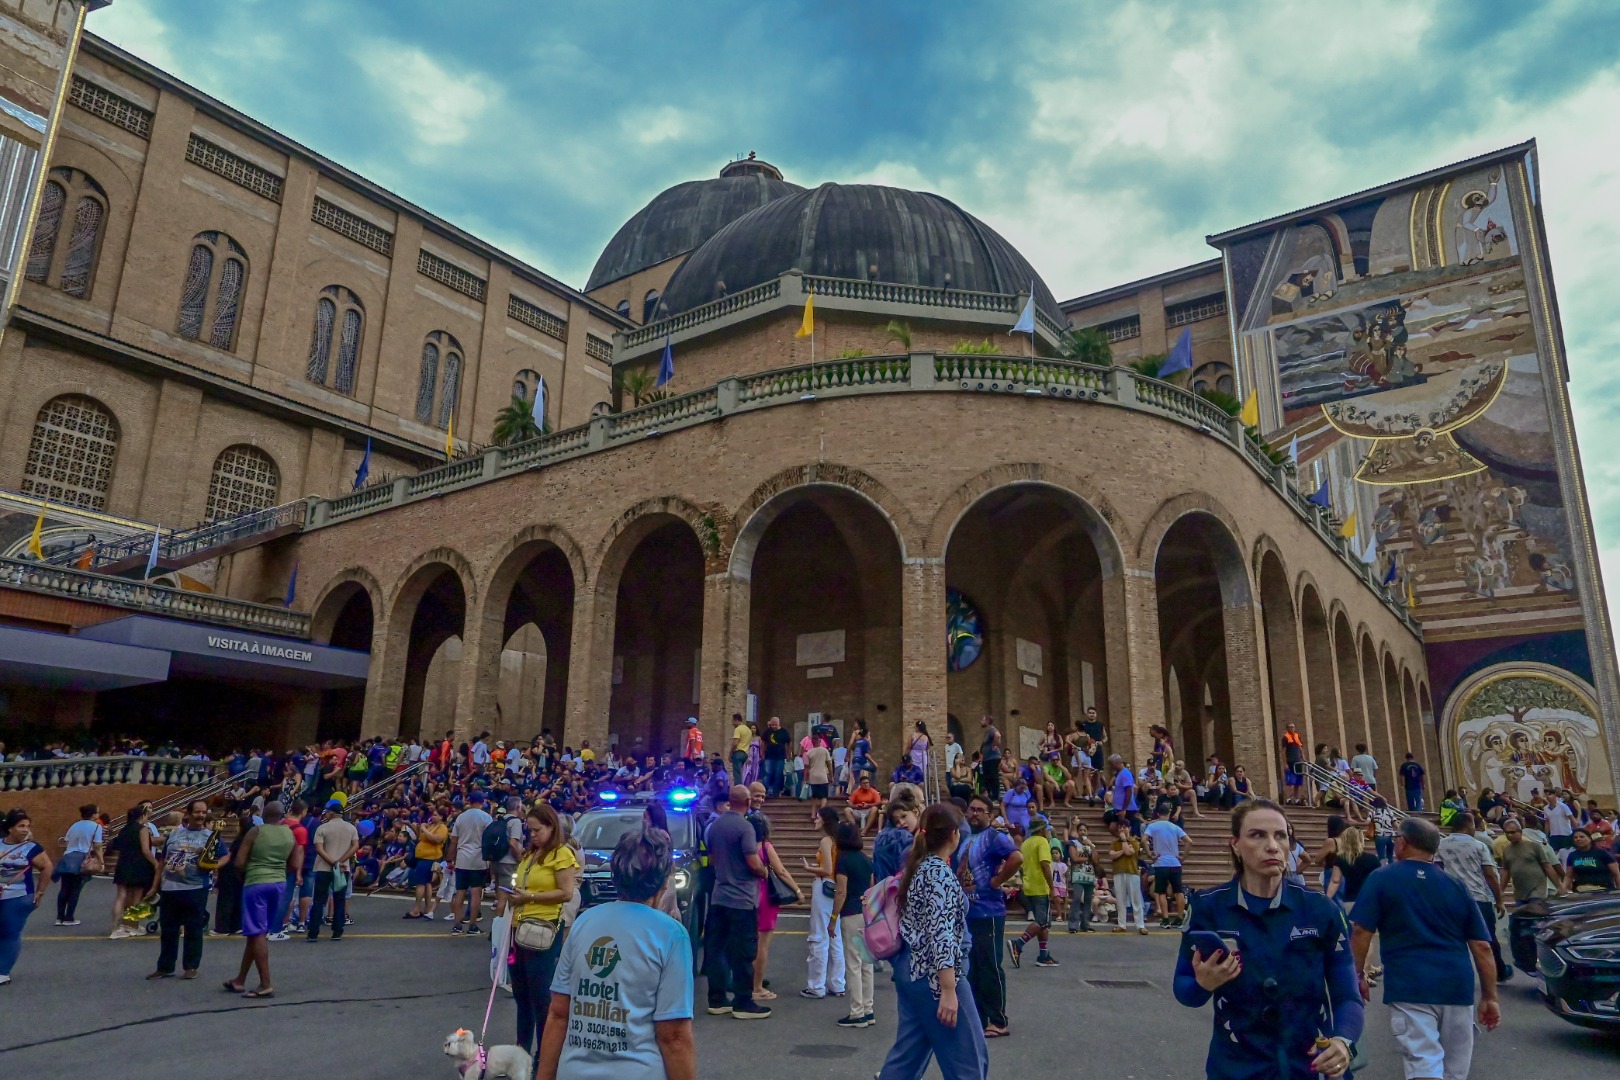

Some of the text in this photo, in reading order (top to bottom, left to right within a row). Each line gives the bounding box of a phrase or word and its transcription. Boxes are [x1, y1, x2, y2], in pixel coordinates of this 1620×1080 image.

[208, 636, 312, 662] VISITA À IMAGEM
[578, 978, 619, 1001] Hotel
